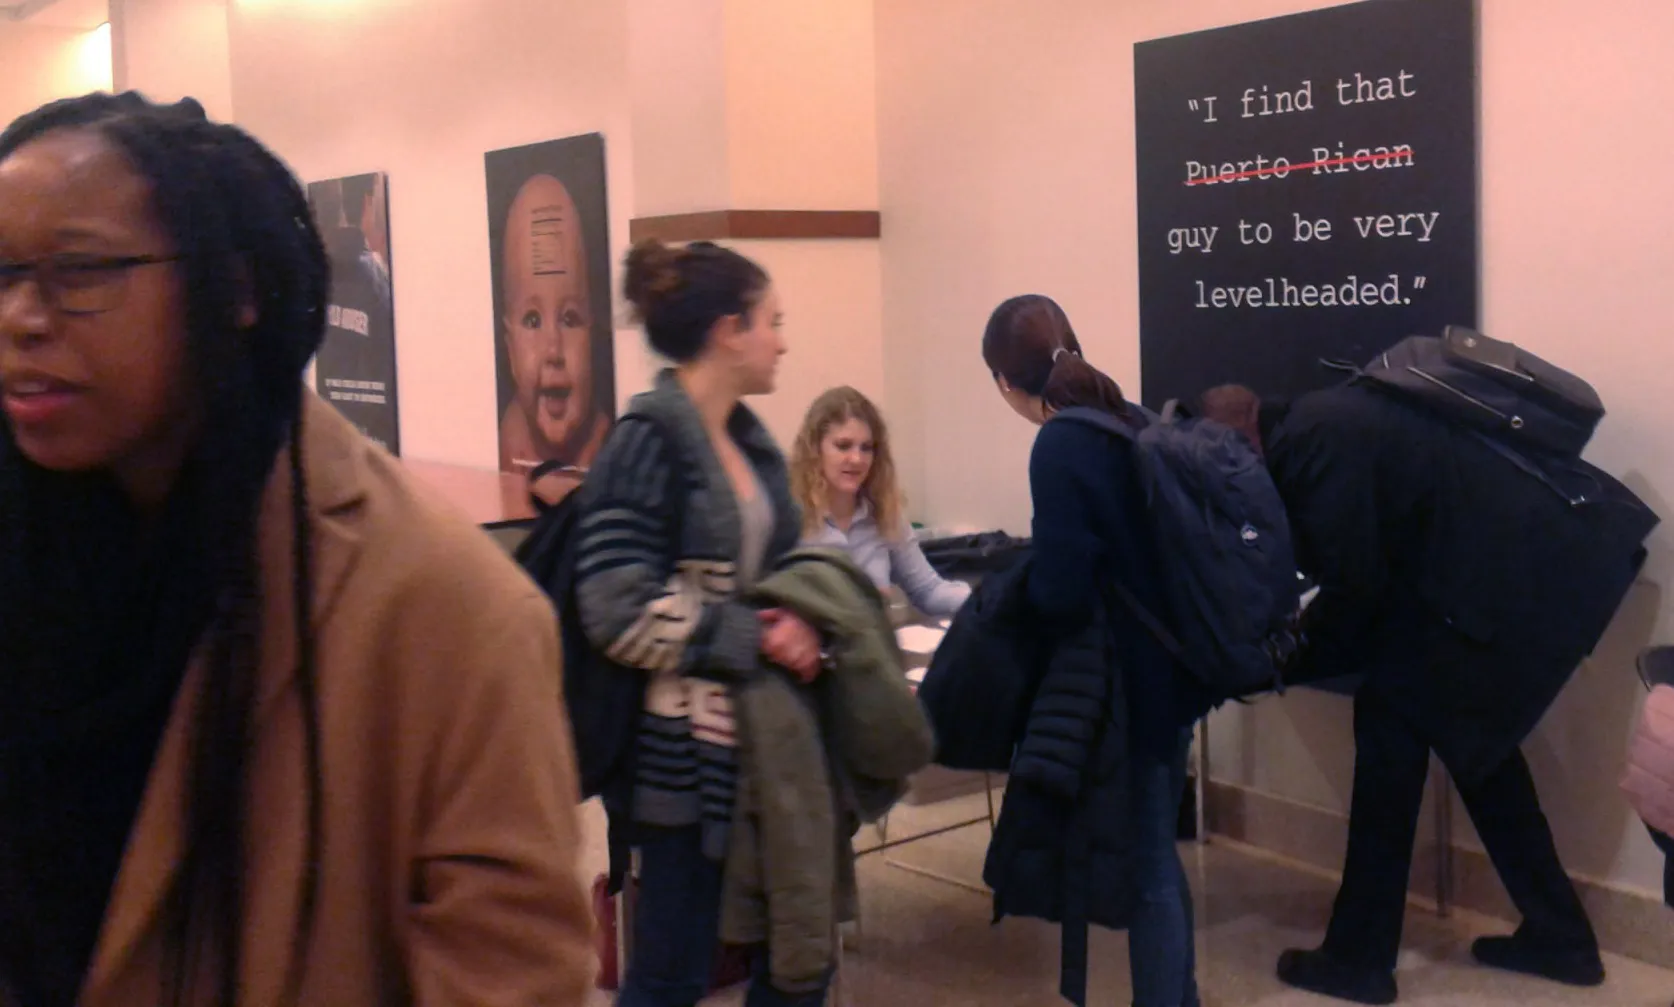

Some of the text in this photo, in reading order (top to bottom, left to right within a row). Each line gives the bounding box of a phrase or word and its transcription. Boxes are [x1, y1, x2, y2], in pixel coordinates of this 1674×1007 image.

[1241, 80, 1314, 119] find
[1336, 69, 1417, 106] that
[1185, 141, 1414, 186] Puerto Rican
[1167, 211, 1440, 254] guy to be very
